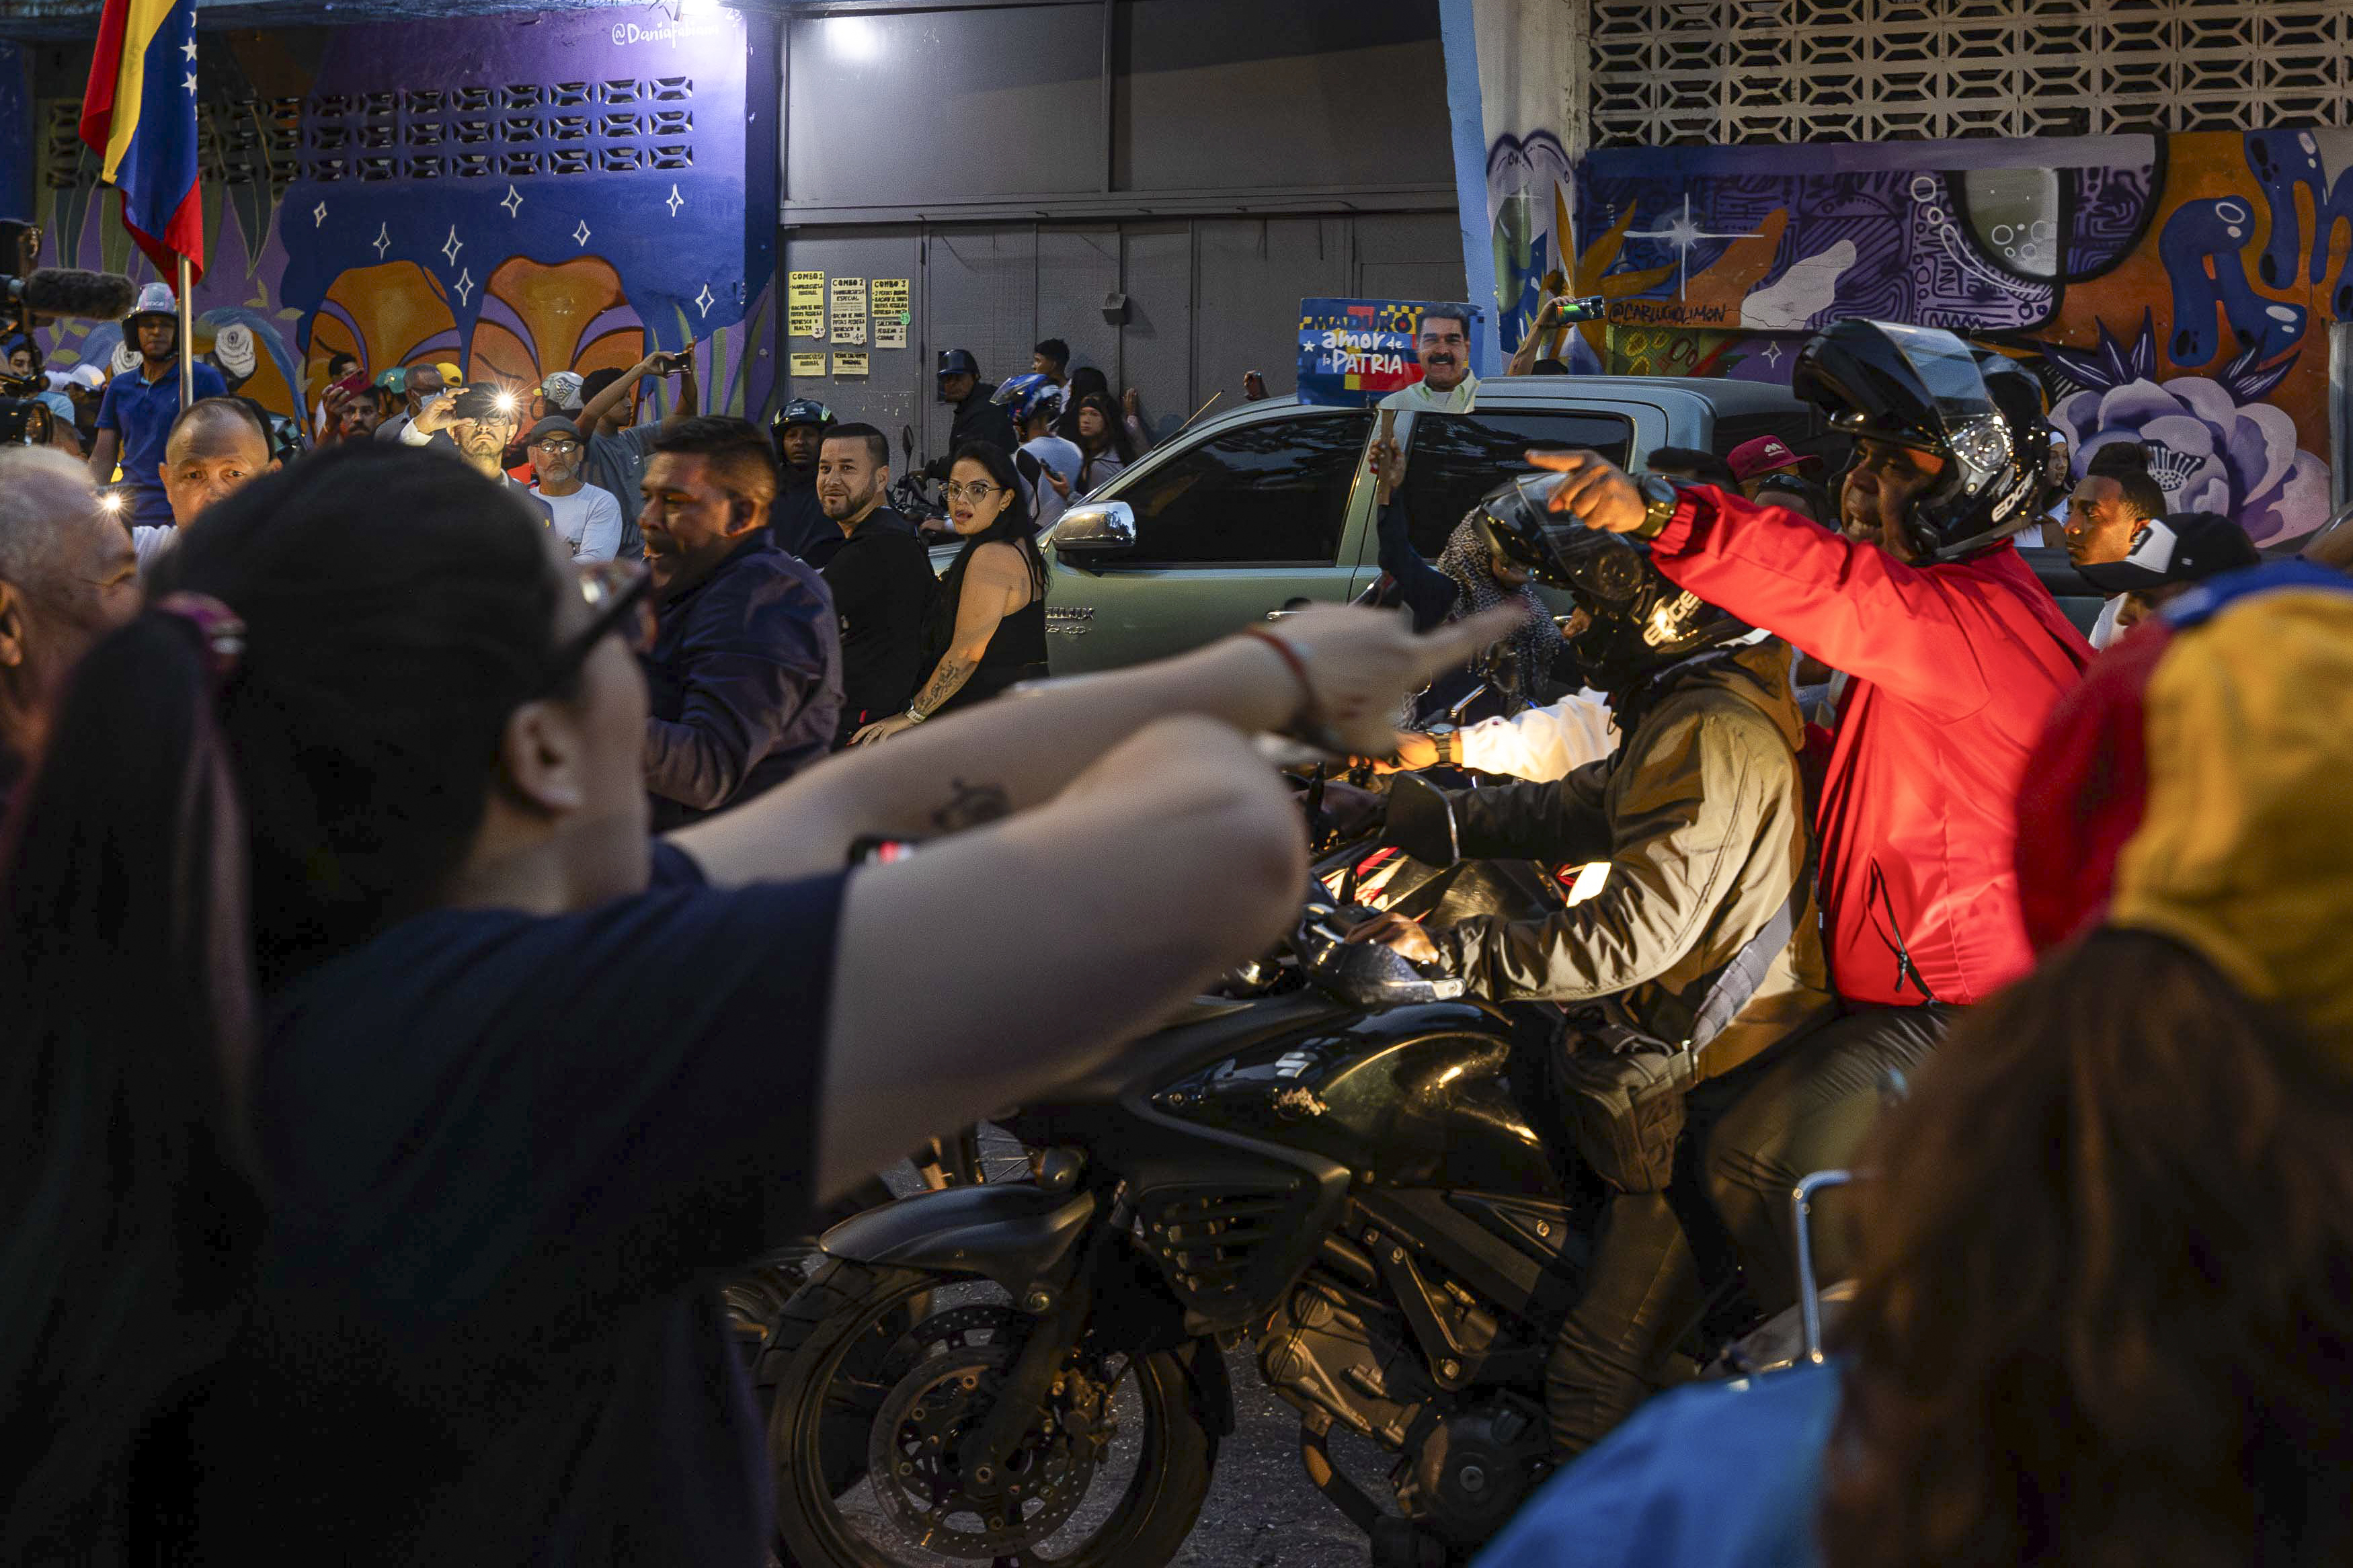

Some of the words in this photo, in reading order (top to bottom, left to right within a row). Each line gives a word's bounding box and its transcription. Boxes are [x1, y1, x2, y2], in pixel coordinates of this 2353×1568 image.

[1322, 331, 1386, 350] amor
[1386, 336, 1405, 349] de
[1332, 348, 1403, 374] PATRIA
